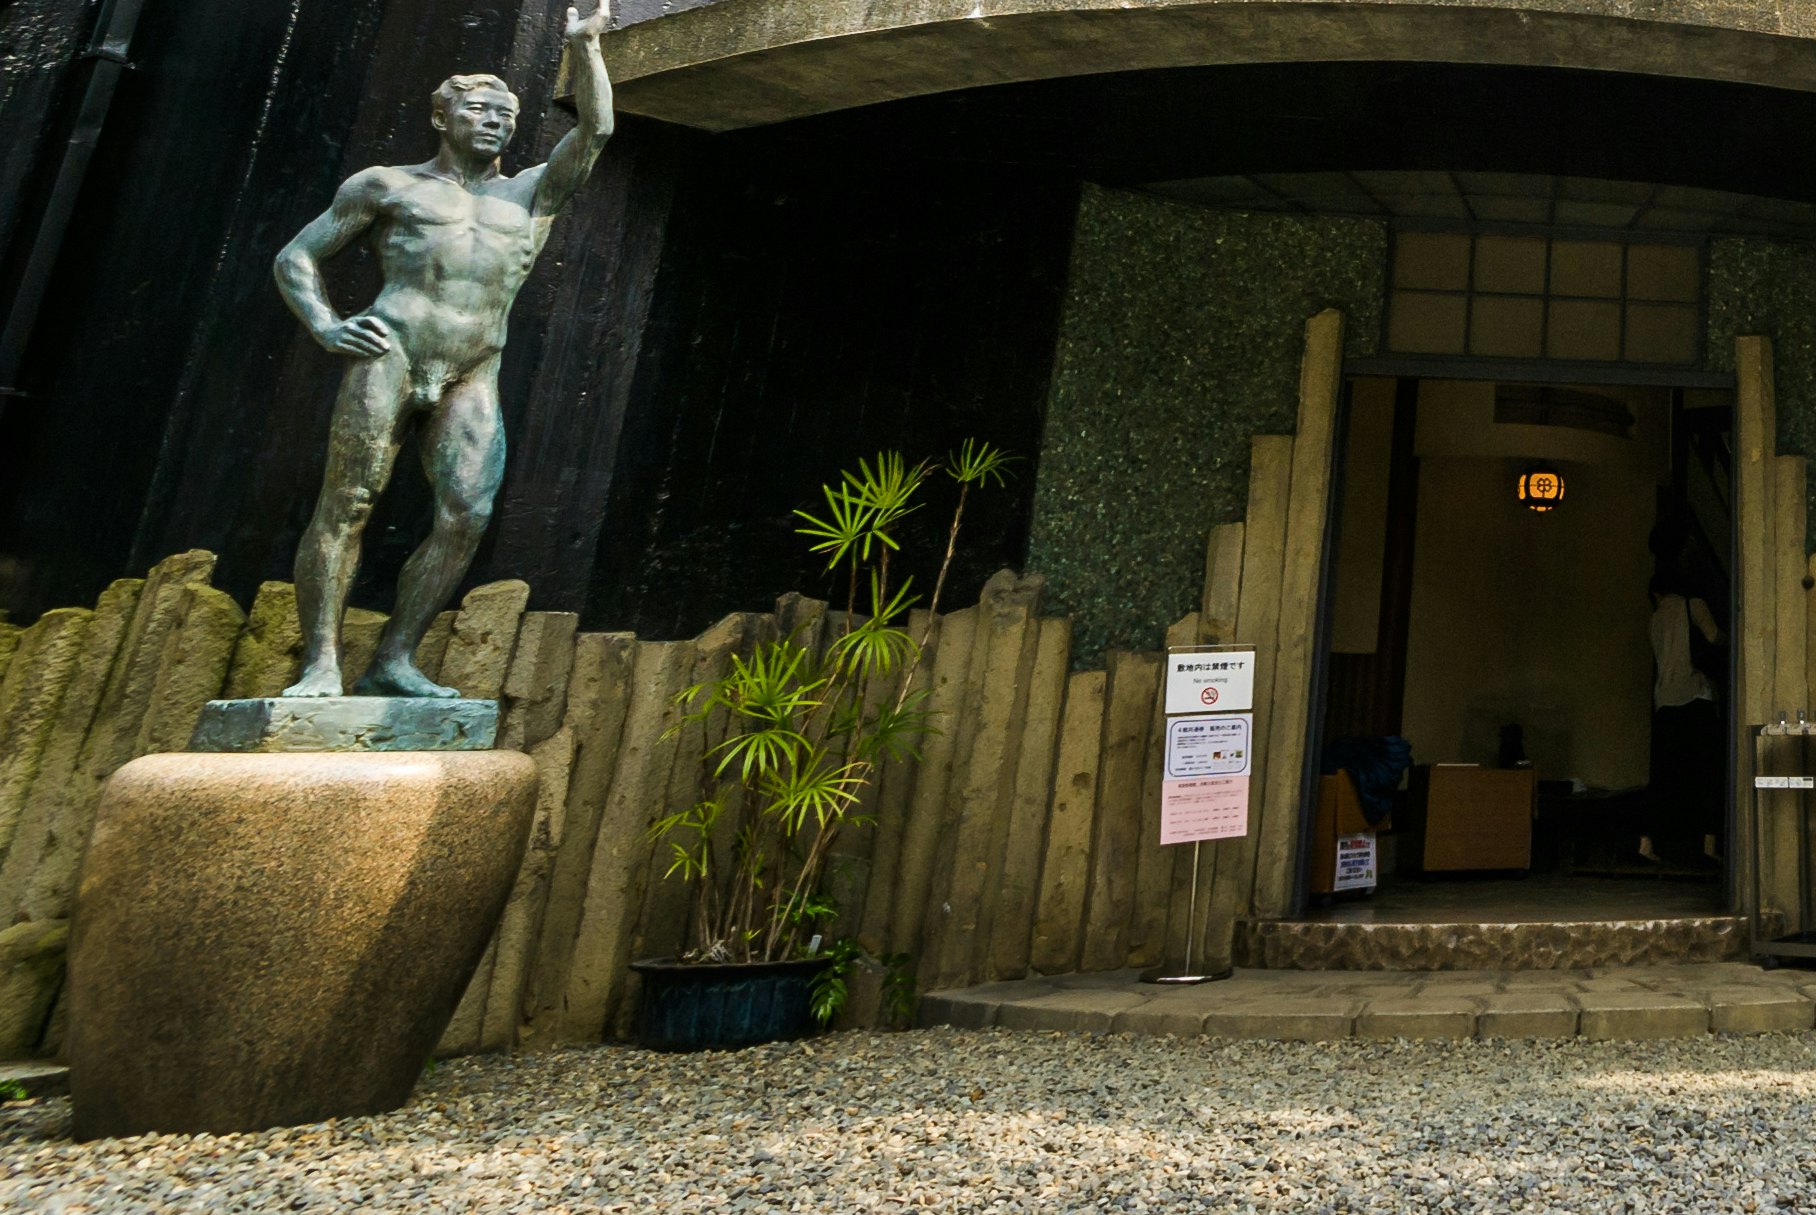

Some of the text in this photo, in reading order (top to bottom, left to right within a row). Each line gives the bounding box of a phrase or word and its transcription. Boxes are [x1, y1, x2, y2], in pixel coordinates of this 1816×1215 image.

[1177, 661, 1245, 673] 敷地内は禁煙です
[1203, 677, 1228, 685] smoking
